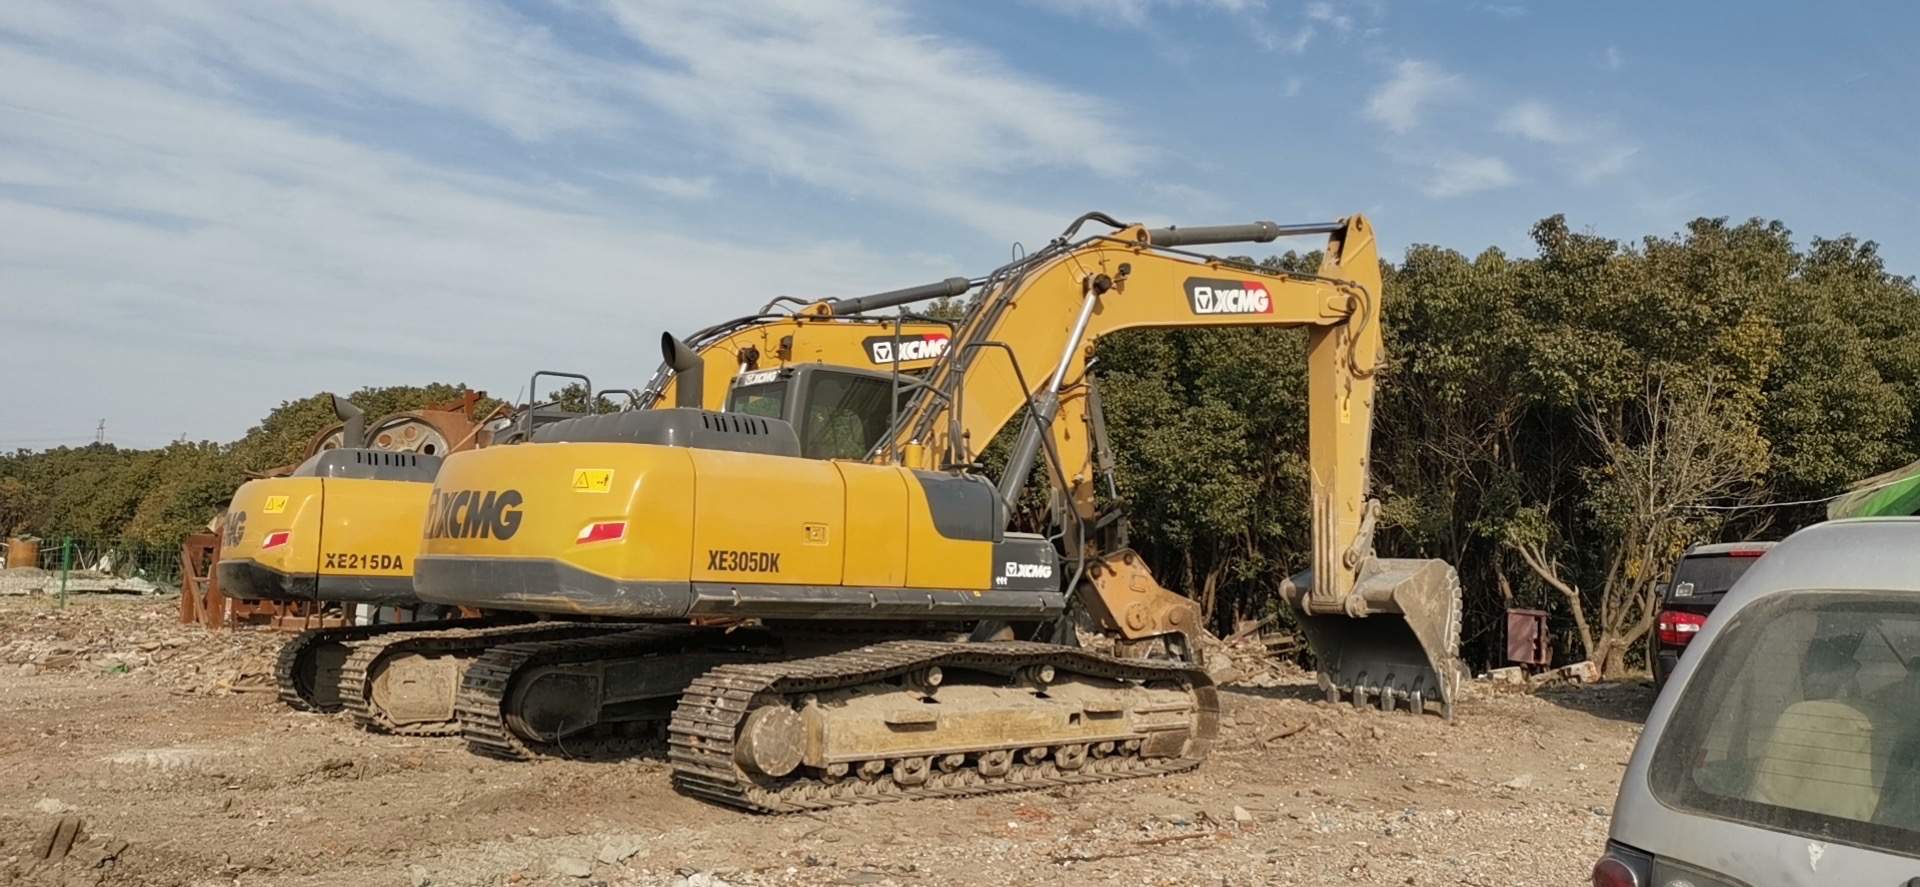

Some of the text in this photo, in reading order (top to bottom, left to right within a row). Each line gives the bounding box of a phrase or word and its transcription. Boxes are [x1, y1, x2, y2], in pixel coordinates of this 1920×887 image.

[1213, 289, 1269, 313] XCMG
[433, 489, 523, 540] XCMG
[325, 553, 403, 570] XE215DA
[707, 550, 780, 573] XE305DK
[1016, 564, 1052, 578] XCMG
